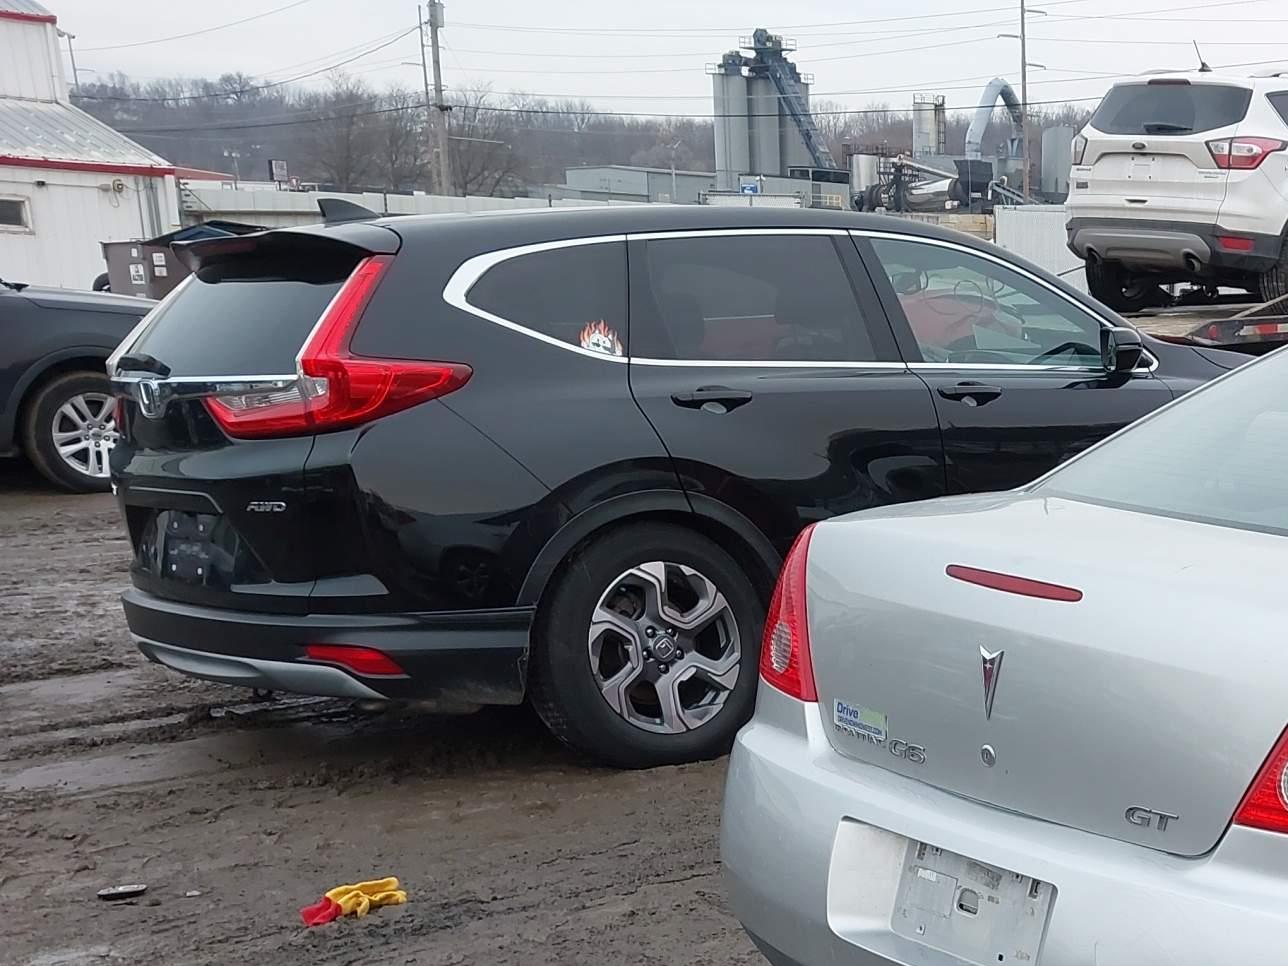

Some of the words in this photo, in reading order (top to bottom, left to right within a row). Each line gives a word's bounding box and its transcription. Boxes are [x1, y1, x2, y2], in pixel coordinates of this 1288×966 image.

[246, 501, 287, 512] AWD
[836, 701, 859, 719] Drive
[888, 738, 927, 765] G6
[1125, 804, 1180, 832] GT
